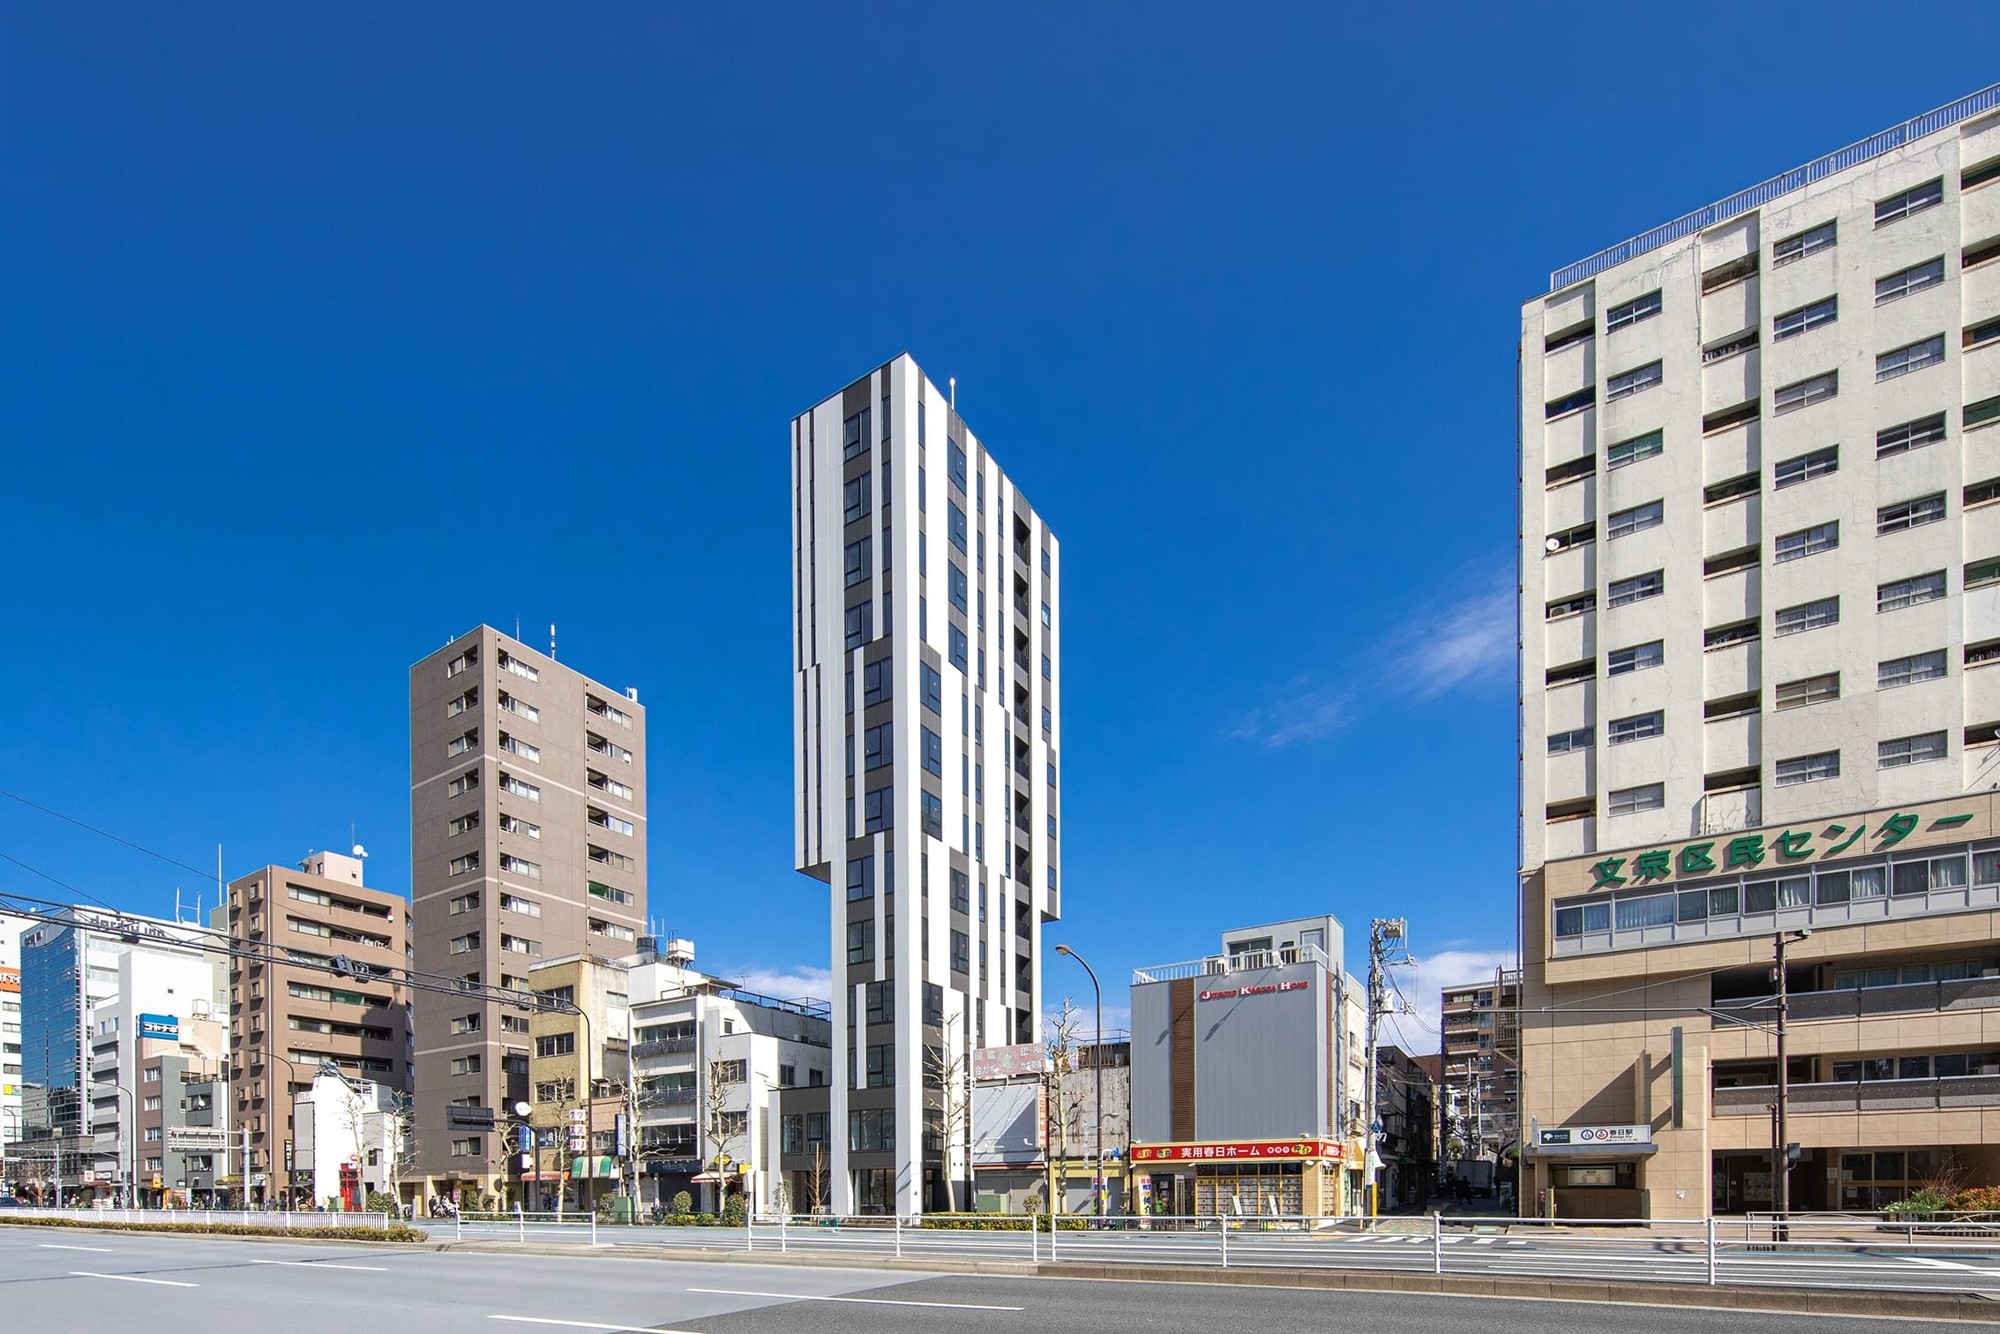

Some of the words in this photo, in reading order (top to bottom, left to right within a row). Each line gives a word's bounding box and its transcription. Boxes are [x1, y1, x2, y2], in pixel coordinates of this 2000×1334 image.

[1594, 812, 1974, 886] 文京区民センター
[1181, 1146, 1260, 1158] 実用春日ホーム
